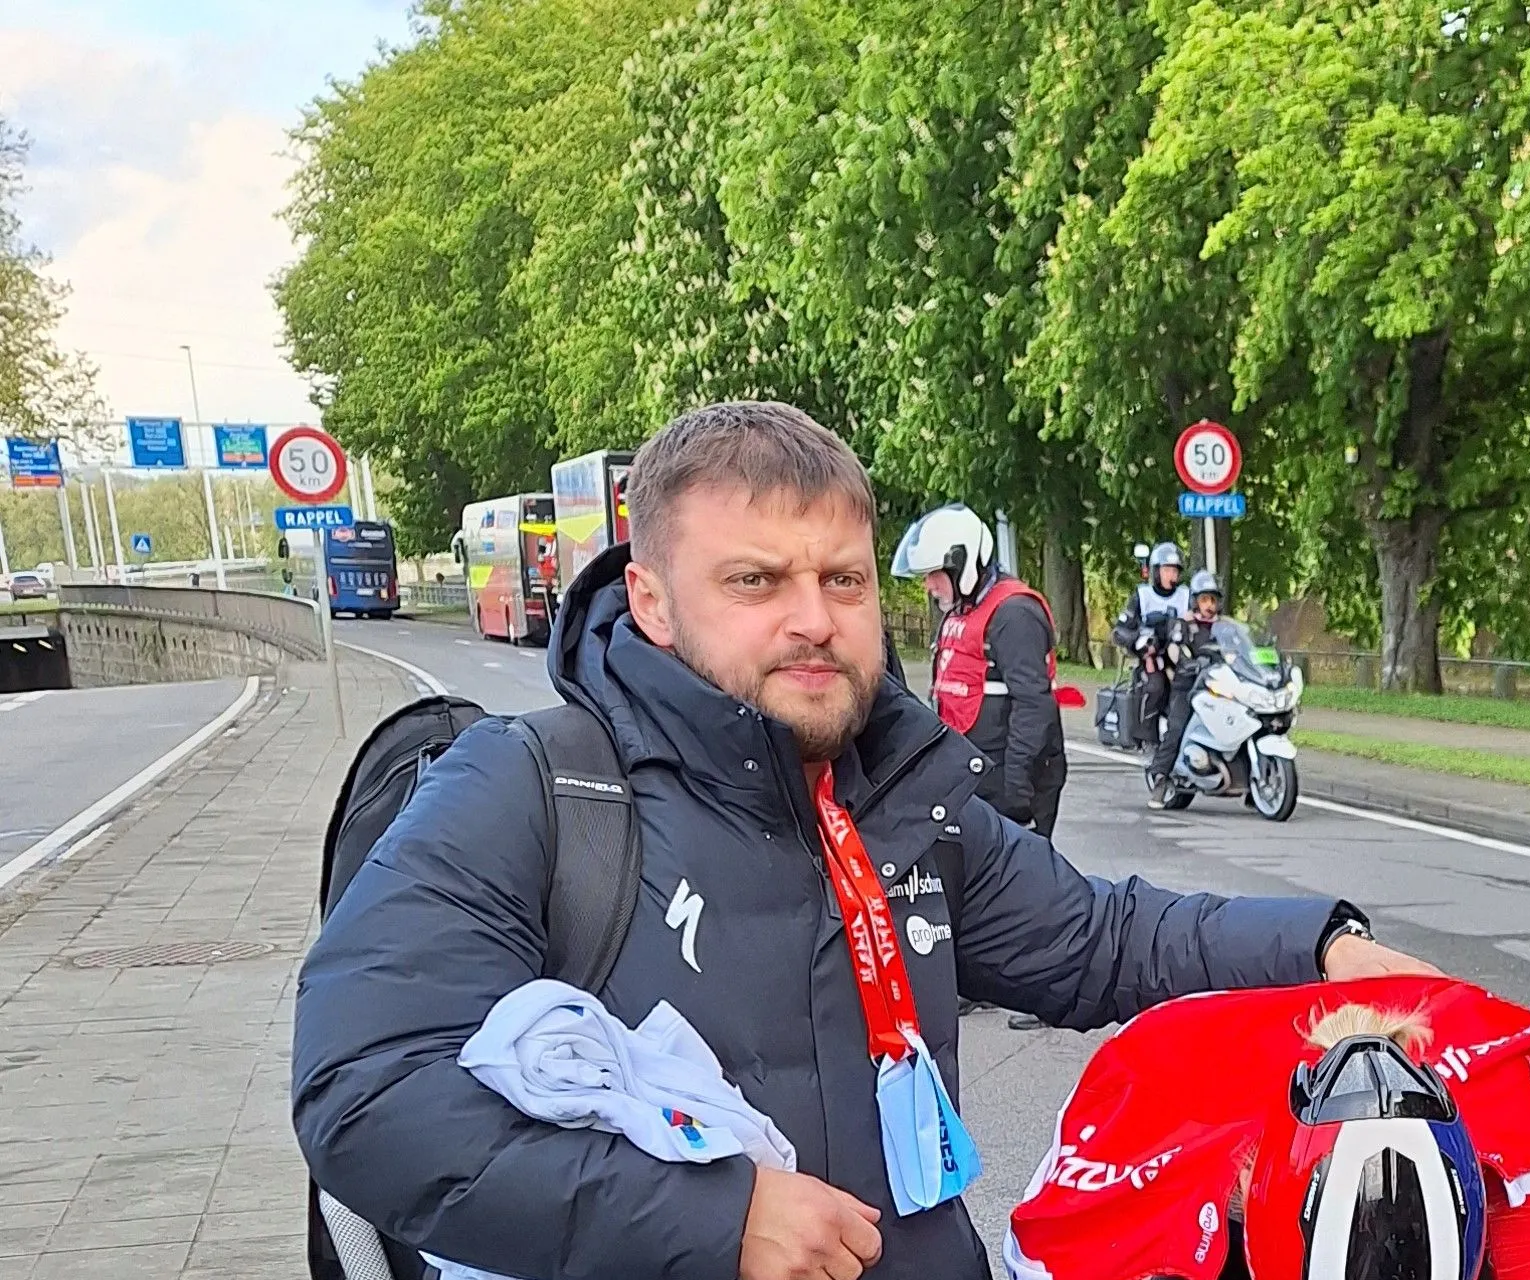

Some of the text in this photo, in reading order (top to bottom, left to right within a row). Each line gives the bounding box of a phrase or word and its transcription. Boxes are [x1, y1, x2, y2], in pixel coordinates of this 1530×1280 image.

[289, 448, 329, 474] 50
[1194, 443, 1225, 466] 50
[299, 474, 320, 486] km
[1183, 495, 1240, 515] RAPPEL
[284, 510, 344, 526] RAPPEL
